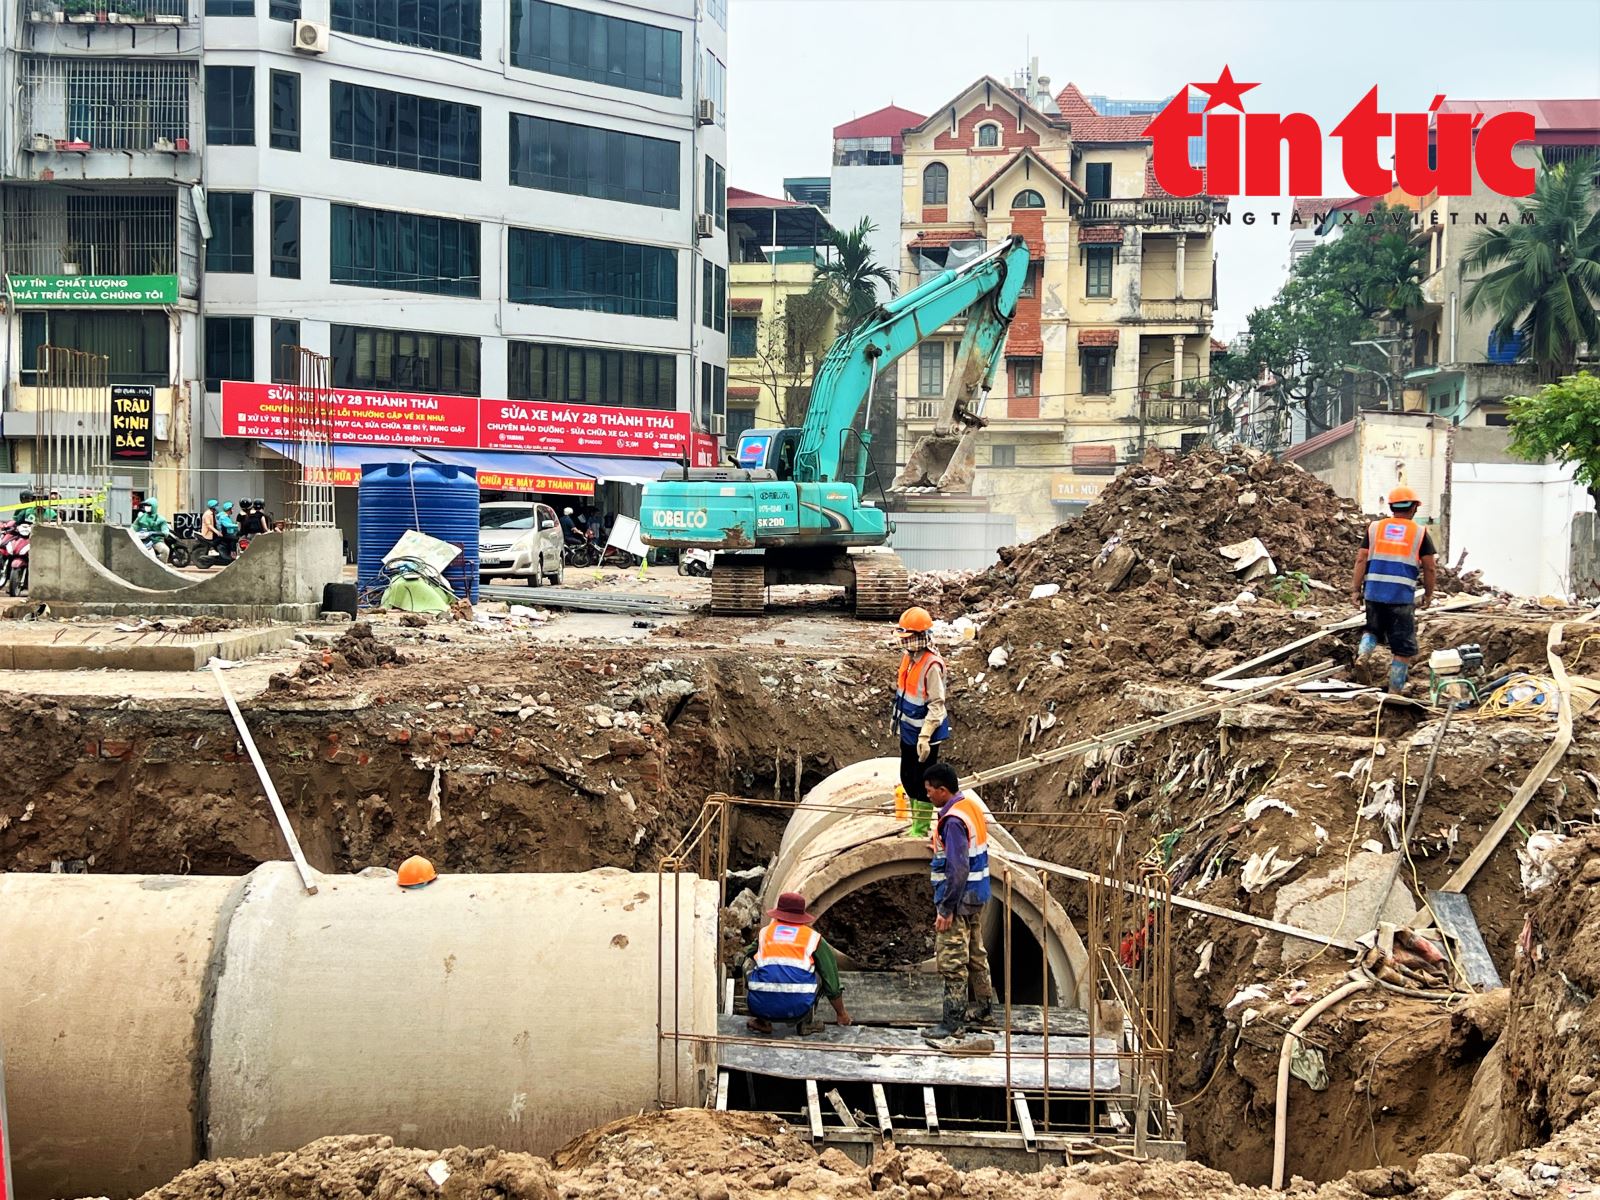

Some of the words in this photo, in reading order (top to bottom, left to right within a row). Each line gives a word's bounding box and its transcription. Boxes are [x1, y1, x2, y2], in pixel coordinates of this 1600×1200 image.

[13, 279, 27, 287] UY
[30, 278, 47, 287] TÍN
[56, 277, 86, 287] CHẤT
[89, 279, 128, 289] LƯỢNG
[41, 288, 70, 299] TRIỂN
[73, 288, 97, 299] CỦA
[100, 289, 142, 299] CHÚNG
[145, 289, 163, 299] TÔI
[114, 398, 150, 413] TRÂU
[347, 394, 362, 405] 28
[365, 395, 407, 408] THÀNH
[410, 397, 438, 409] THÁI
[113, 415, 149, 430] KINH
[501, 404, 528, 419] SỬA
[531, 409, 548, 421] XE
[551, 409, 579, 423] MÁY
[582, 412, 597, 424] 28
[600, 412, 643, 427] THÀNH
[646, 415, 674, 428] THÁI
[487, 422, 518, 431] CHUYÊN
[634, 431, 643, 439] XE
[115, 431, 145, 447] BẮC
[480, 474, 501, 485] CHỮA
[503, 477, 514, 486] XE
[516, 477, 534, 488] MÁY
[536, 479, 546, 488] 28
[548, 480, 574, 490] THÀNH
[576, 481, 593, 491] THÁI
[653, 510, 707, 529] KOBELCO
